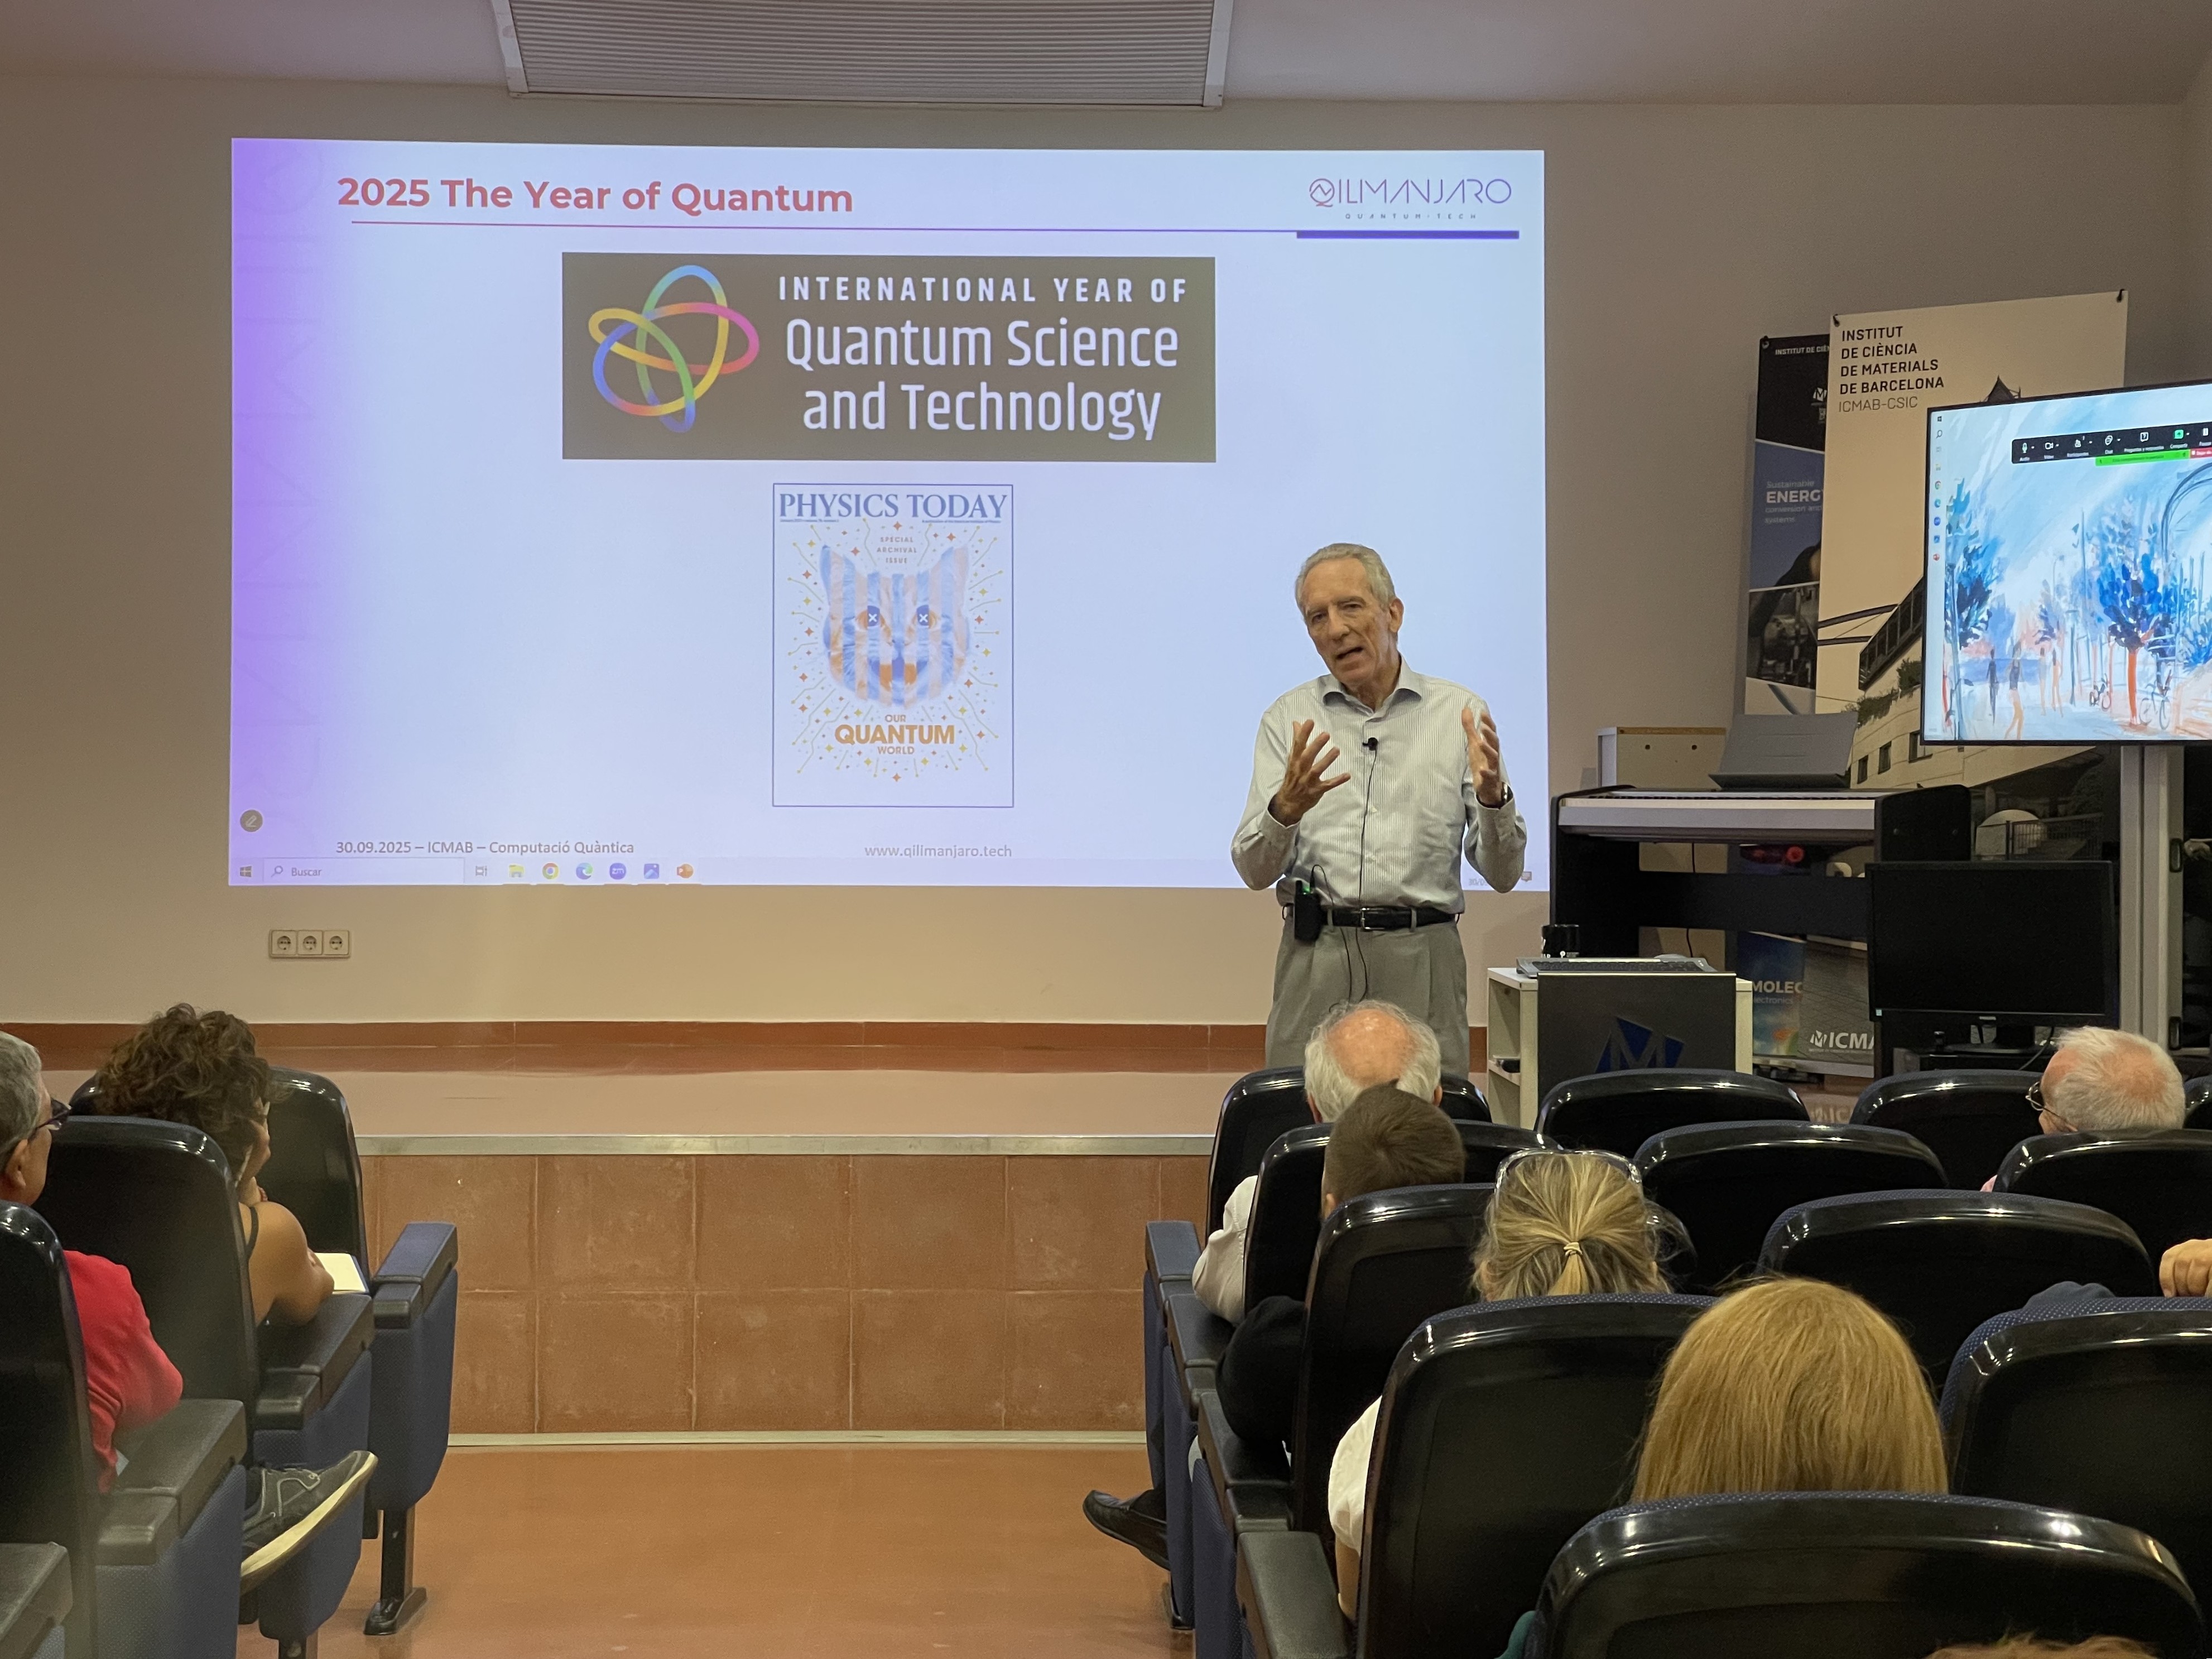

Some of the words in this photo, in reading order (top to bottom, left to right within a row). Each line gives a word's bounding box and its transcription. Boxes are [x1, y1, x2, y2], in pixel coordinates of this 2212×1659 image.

[337, 177, 430, 207] 2025
[440, 177, 513, 208] The
[523, 181, 611, 209] Year
[622, 181, 662, 210] of
[671, 182, 853, 217] Quantum
[1309, 178, 1512, 208] QILIMANJARO
[780, 276, 1036, 302] INTERNATIONAL
[1053, 278, 1132, 302] YEAR
[1151, 278, 1186, 302] OF
[1842, 326, 1903, 342] INSTITUT
[787, 318, 991, 371] Quantum
[1007, 317, 1178, 367] Science
[1841, 348, 1858, 359] DE
[1862, 343, 1917, 358] CIÈNCIA
[1840, 366, 1858, 377] DE
[1862, 359, 1939, 376] MATERIALS
[1840, 383, 1857, 395] DE
[1861, 377, 1944, 393] BARCELONA
[803, 381, 886, 430] and
[901, 381, 1161, 441] Technology
[1839, 396, 1918, 412] ICMAB-CSIC
[1766, 480, 1815, 489] Sustainable
[1766, 489, 1824, 503] ENERG
[780, 493, 899, 518] PHYSICS
[906, 494, 1007, 518] TODAY
[884, 714, 906, 723] OUR
[834, 724, 955, 746] QUANTUM
[877, 746, 915, 755] WORLD
[335, 841, 411, 854] 30.09.2025
[427, 841, 473, 853] ICMAB
[489, 840, 570, 856] Computació
[574, 840, 634, 854] Quàntica
[864, 844, 1012, 859] www.qilimanjaro.tech
[291, 867, 322, 877] Buscar
